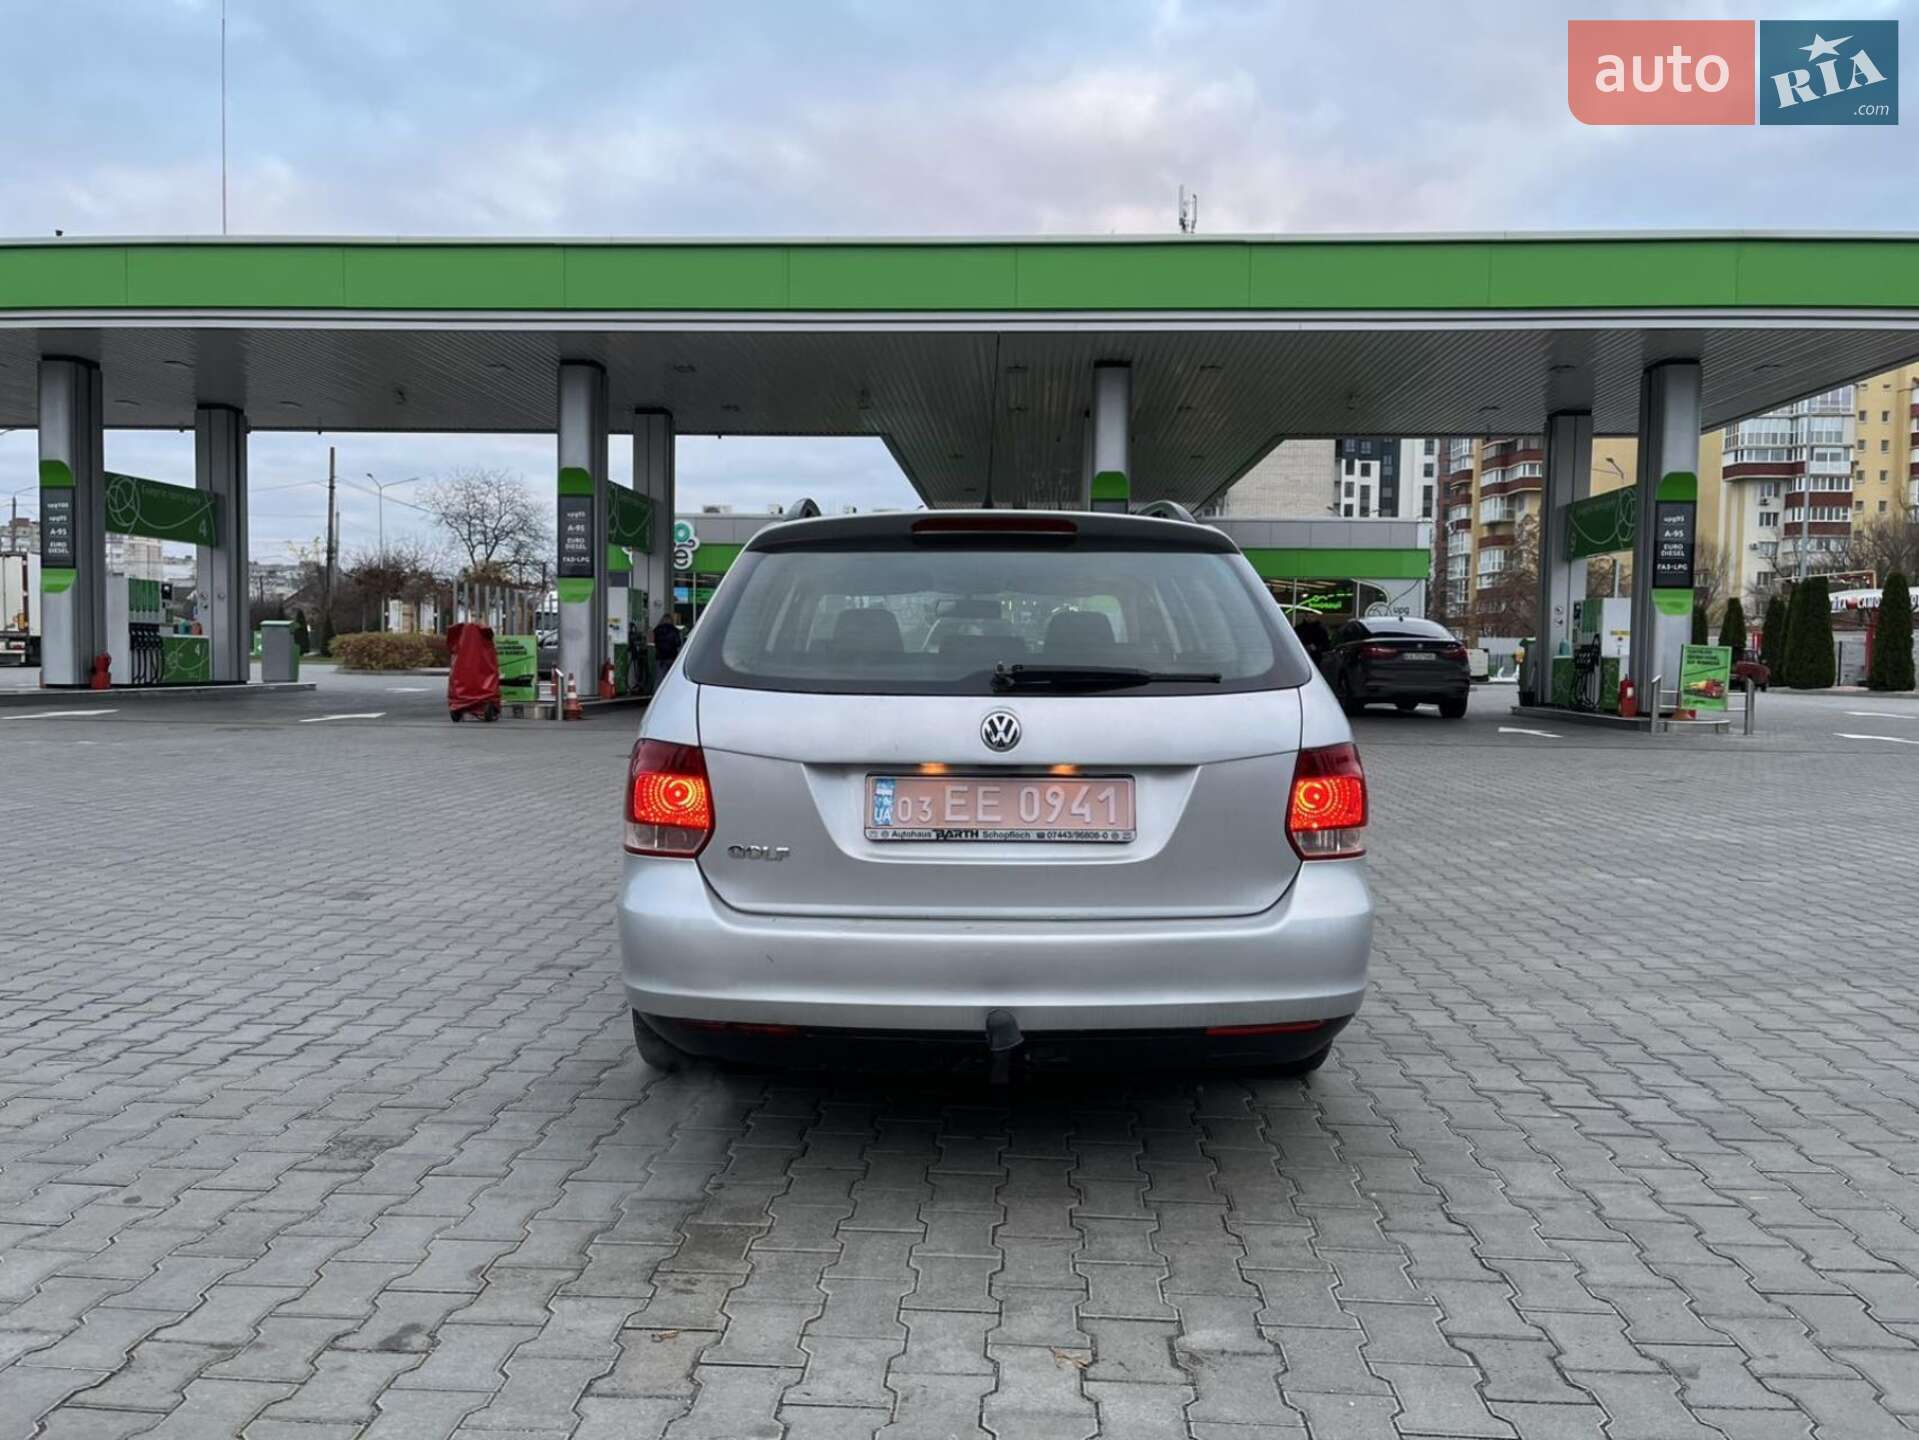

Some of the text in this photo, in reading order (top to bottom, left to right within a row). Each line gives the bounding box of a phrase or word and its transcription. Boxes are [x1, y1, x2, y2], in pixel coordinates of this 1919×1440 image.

[897, 785, 1118, 824] 03 EE 0941
[874, 806, 894, 825] UA
[891, 830, 933, 838] Autohaus
[933, 829, 979, 840] BARTH
[727, 845, 790, 861] GOLF
